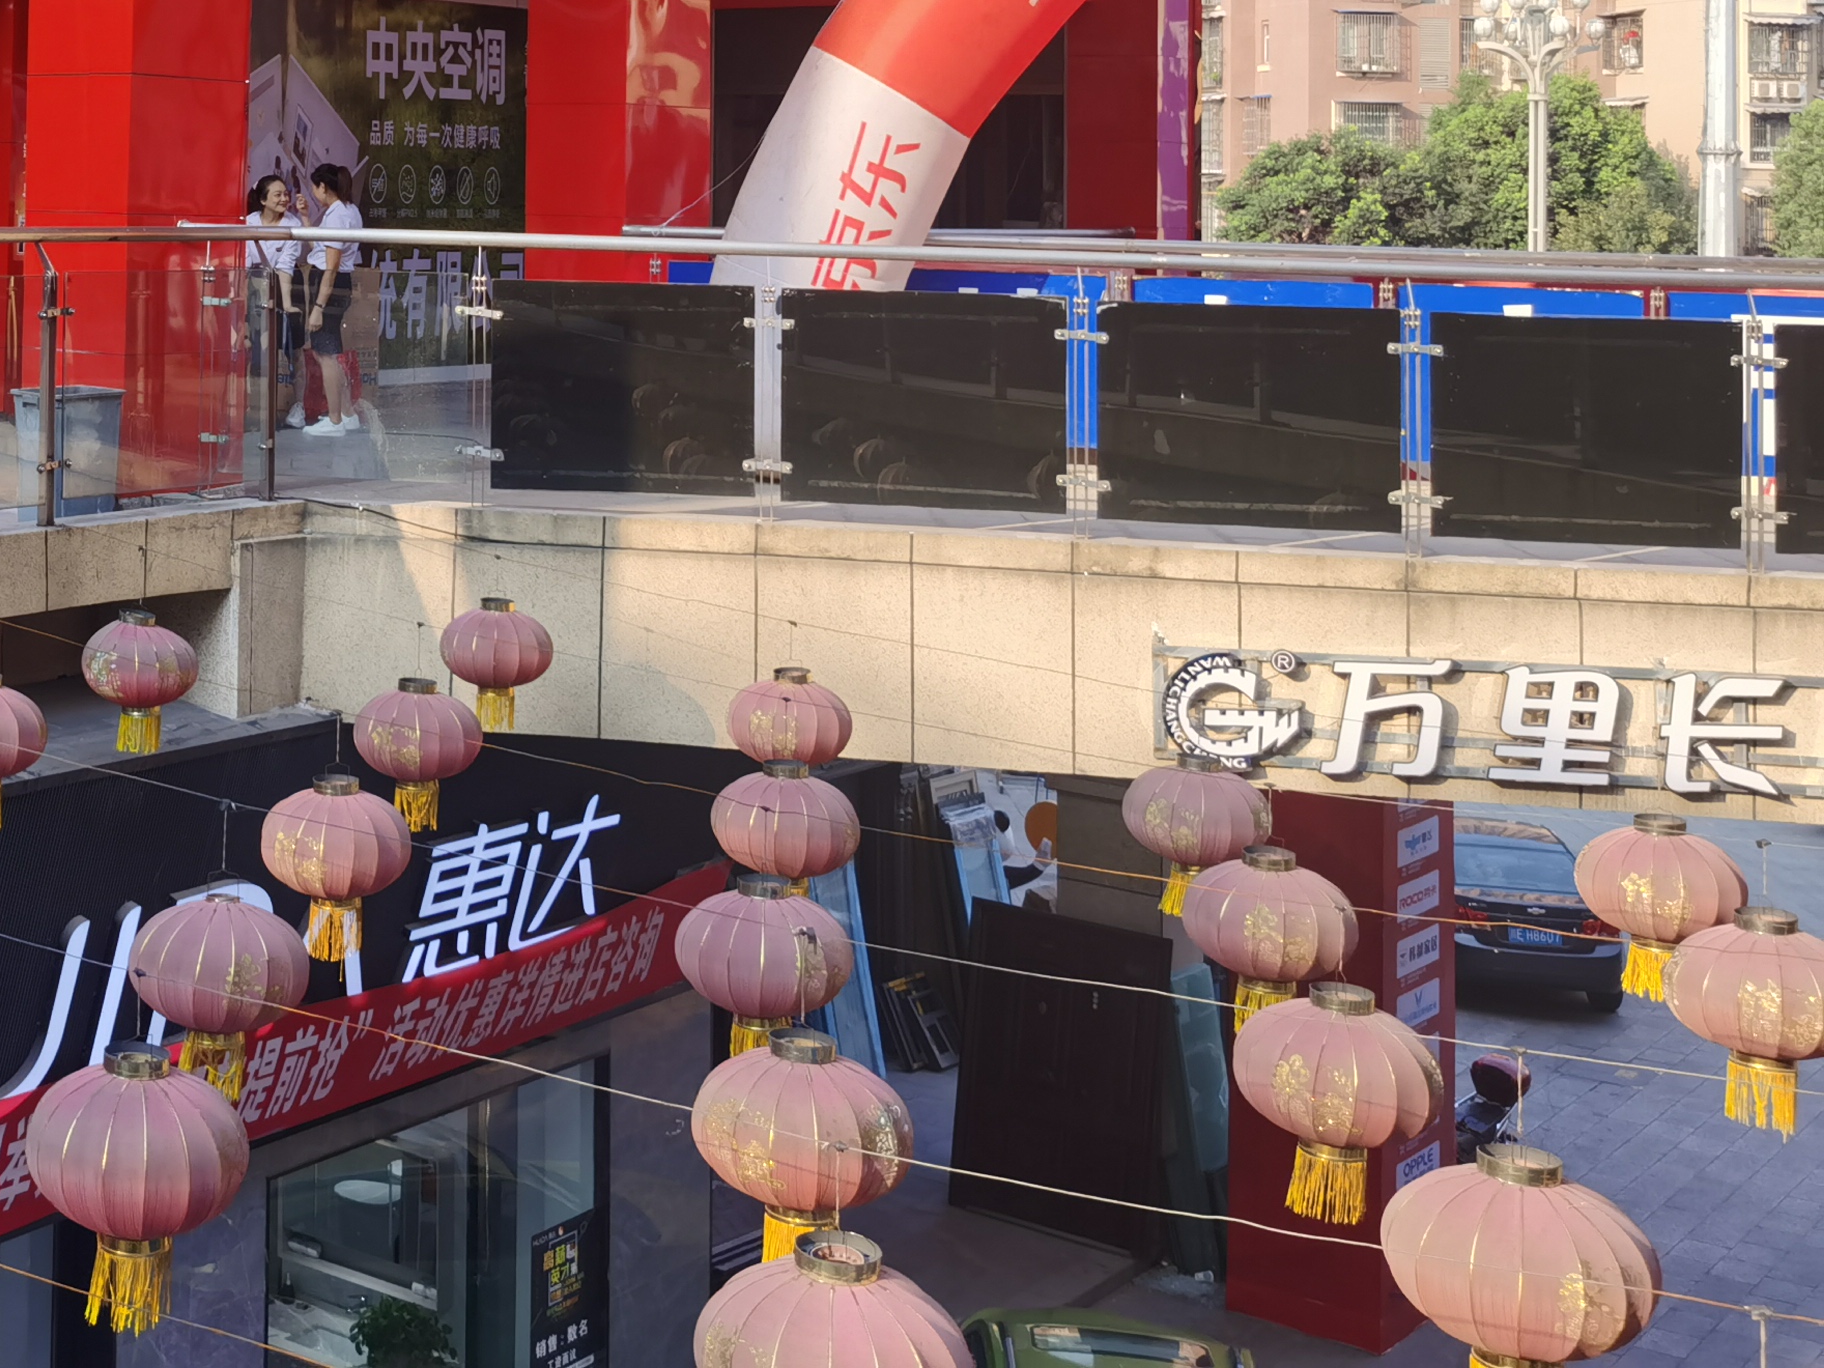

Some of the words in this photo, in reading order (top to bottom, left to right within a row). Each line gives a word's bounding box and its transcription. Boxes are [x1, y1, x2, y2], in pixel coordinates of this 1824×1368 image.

[365, 16, 507, 105] 中央空调
[370, 119, 395, 145] 品质
[403, 122, 501, 150] 为每一次健康呼吸
[1320, 660, 1788, 797] 万里长
[401, 793, 621, 983] 惠达
[1402, 1147, 1434, 1178] OPPLE
